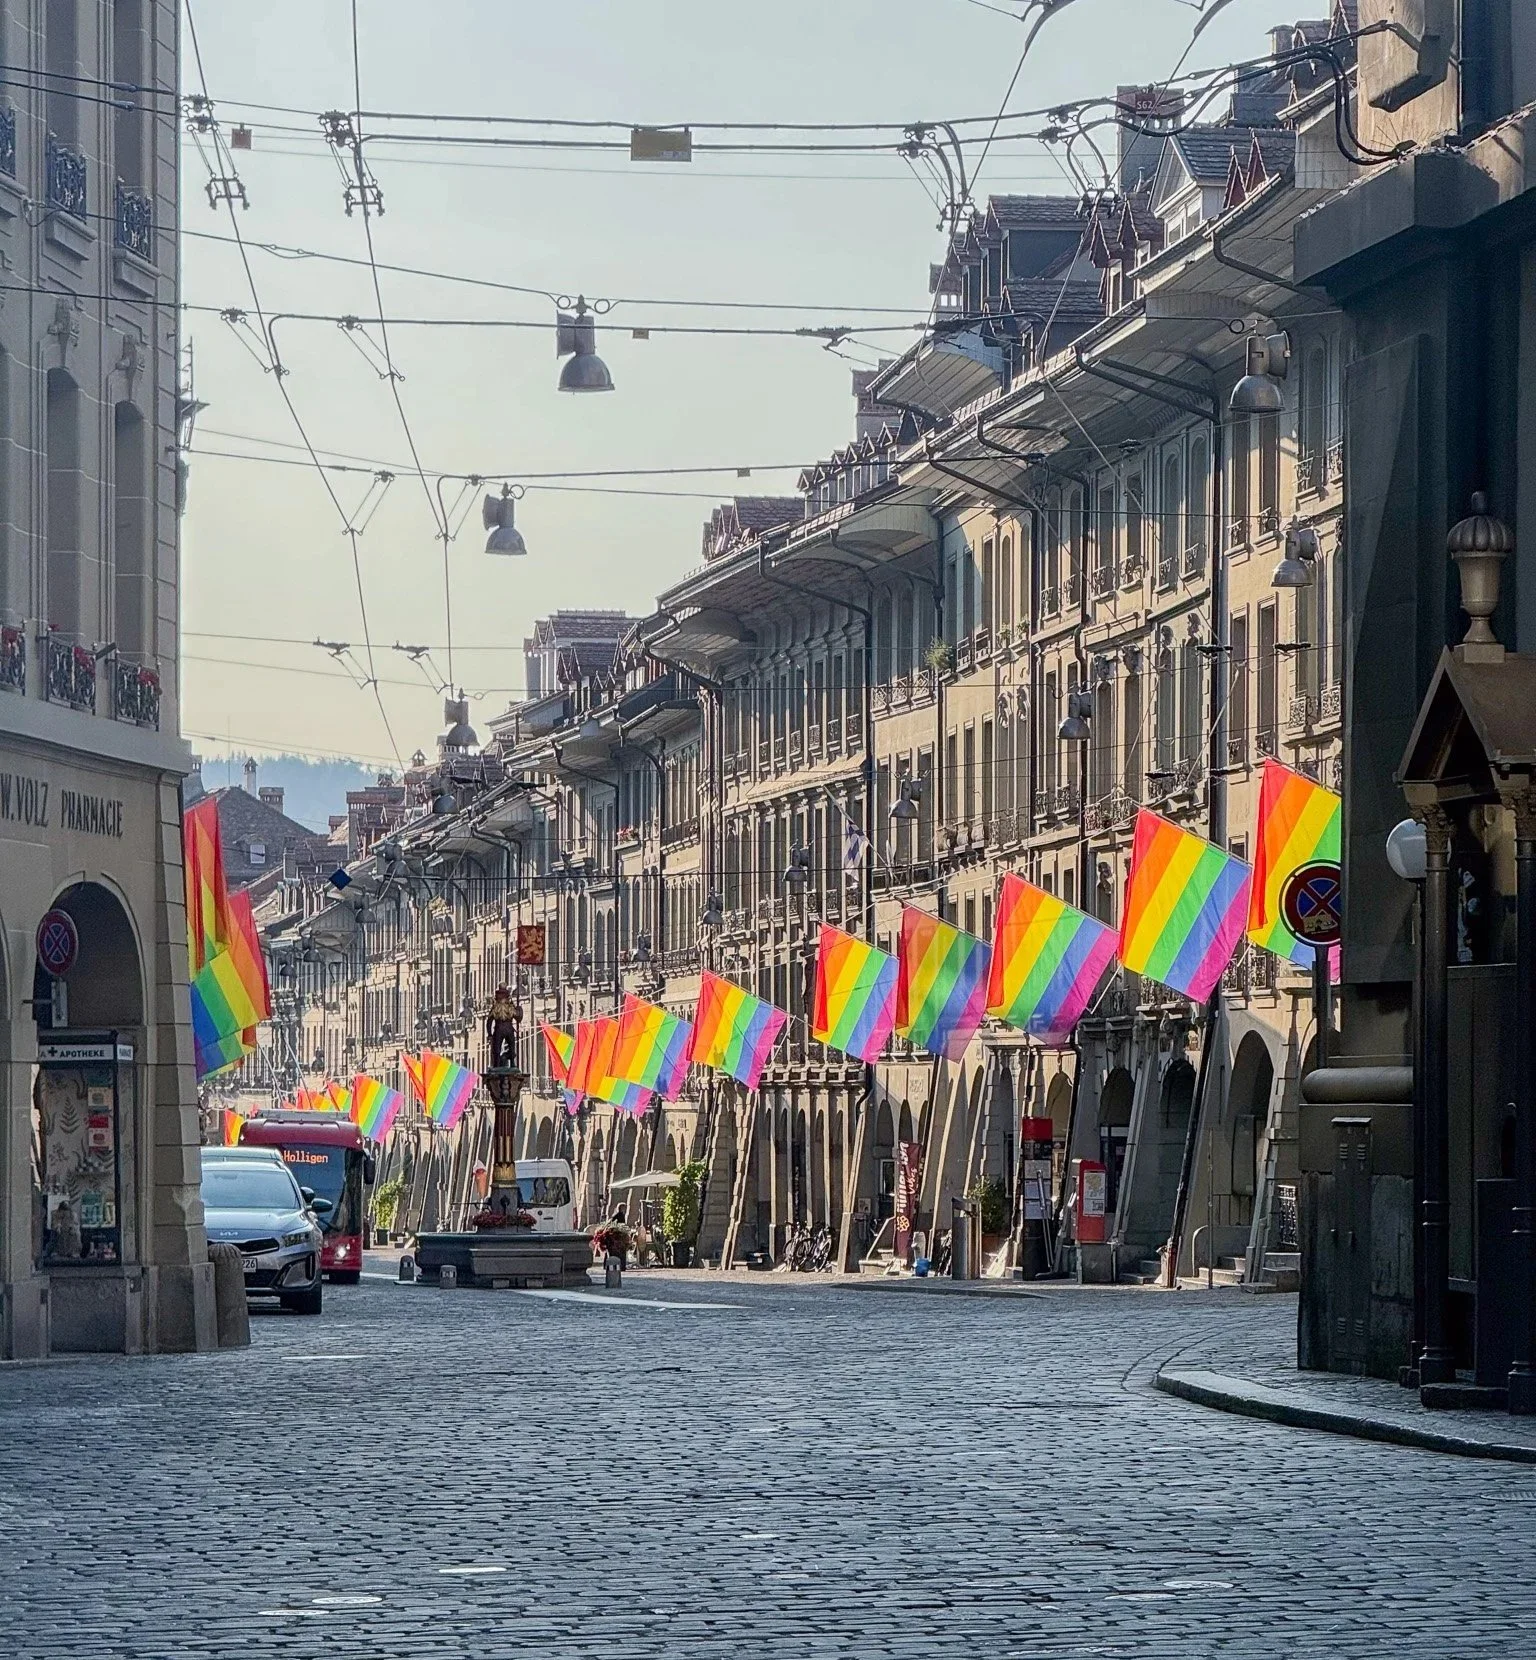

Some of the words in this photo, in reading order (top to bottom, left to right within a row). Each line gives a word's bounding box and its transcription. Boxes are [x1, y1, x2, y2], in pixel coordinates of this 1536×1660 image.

[61, 788, 123, 838] PHARMACIE
[60, 1049, 104, 1058] APOTHEKE
[283, 1149, 329, 1164] Holligen
